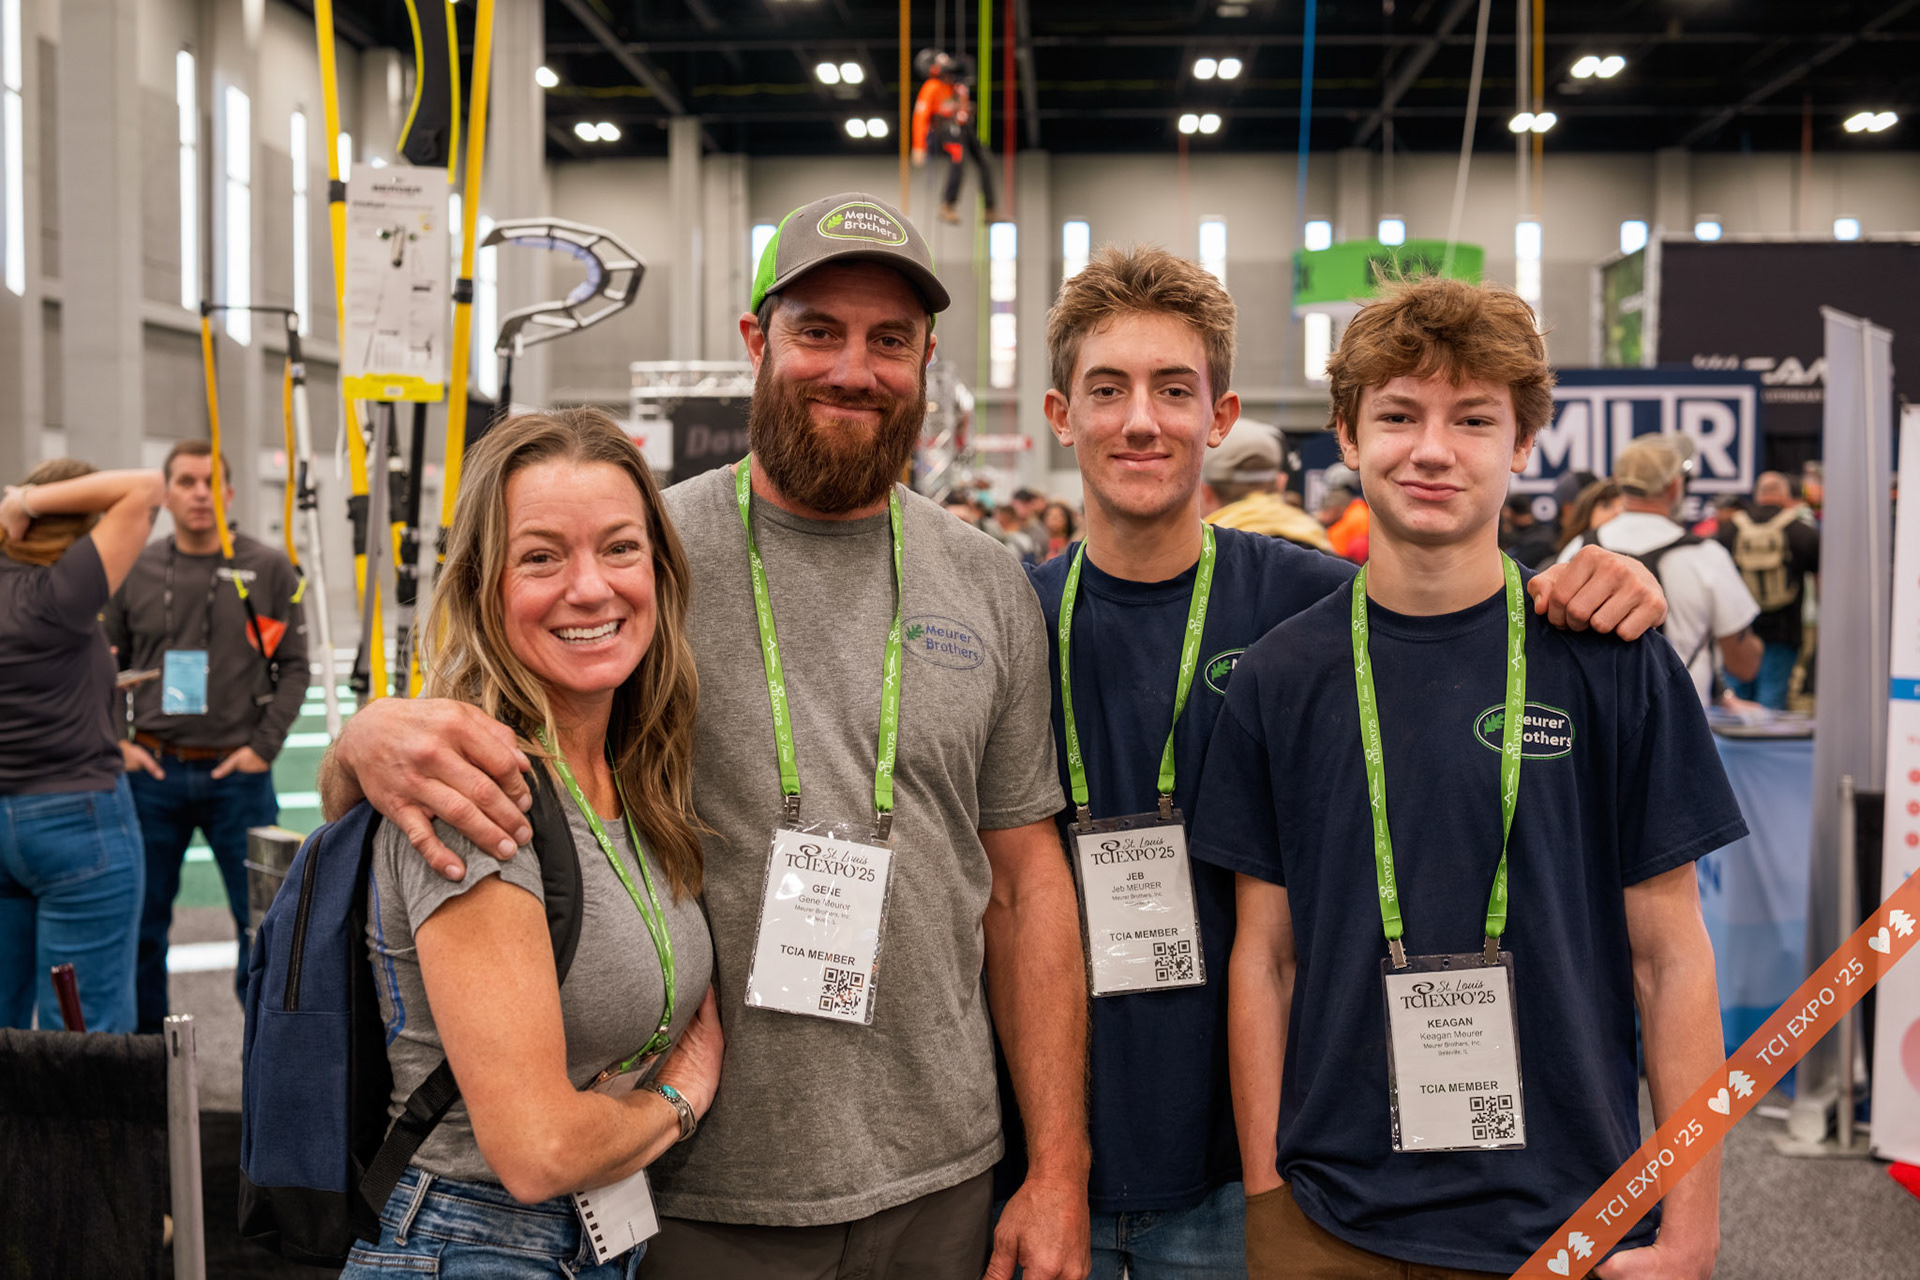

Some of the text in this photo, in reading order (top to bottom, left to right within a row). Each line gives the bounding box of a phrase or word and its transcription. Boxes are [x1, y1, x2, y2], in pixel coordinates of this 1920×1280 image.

[845, 211, 891, 227] Meurer
[844, 221, 898, 240] Brothers
[925, 624, 972, 644] Meurer
[926, 637, 979, 661] Brothers
[1523, 715, 1565, 729] eurer
[1139, 836, 1164, 849] Louis
[841, 850, 868, 865] Louis
[1126, 872, 1145, 881] JEB
[812, 884, 841, 898] GENE
[1112, 881, 1162, 893] Jeb MEURER
[799, 894, 820, 906] Gene
[1110, 927, 1178, 941] TCIA MEMBER
[781, 944, 856, 966] TCIA MEMBER
[1456, 979, 1484, 992] Louis
[1427, 1017, 1473, 1029] KEAGAN
[1420, 1030, 1483, 1042] Keagan Meurer
[1420, 1081, 1499, 1094] TCIA MEMBER
